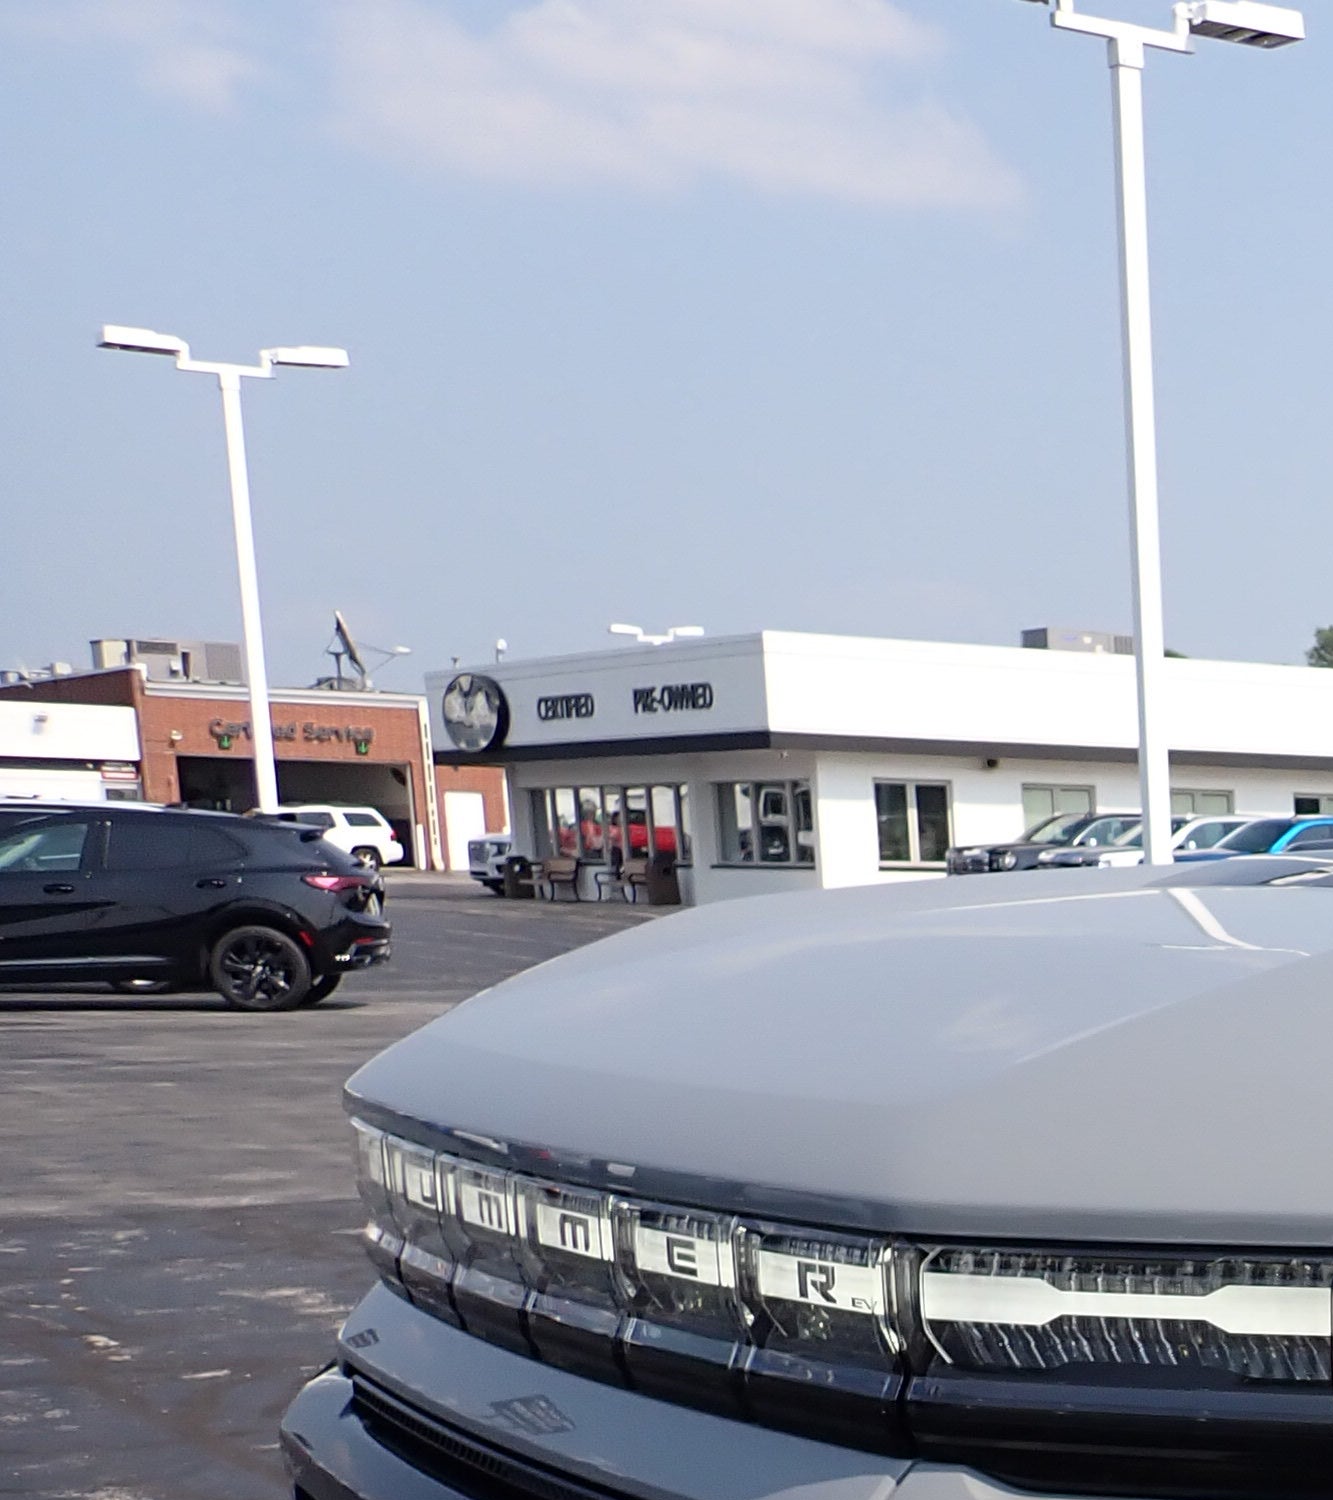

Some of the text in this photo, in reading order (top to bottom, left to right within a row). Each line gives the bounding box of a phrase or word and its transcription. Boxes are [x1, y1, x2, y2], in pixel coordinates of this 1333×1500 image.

[537, 682, 714, 721] CERTIFIED PRE-OWNED
[209, 718, 374, 744] Certed Service
[419, 1169, 837, 1305] UMMER
